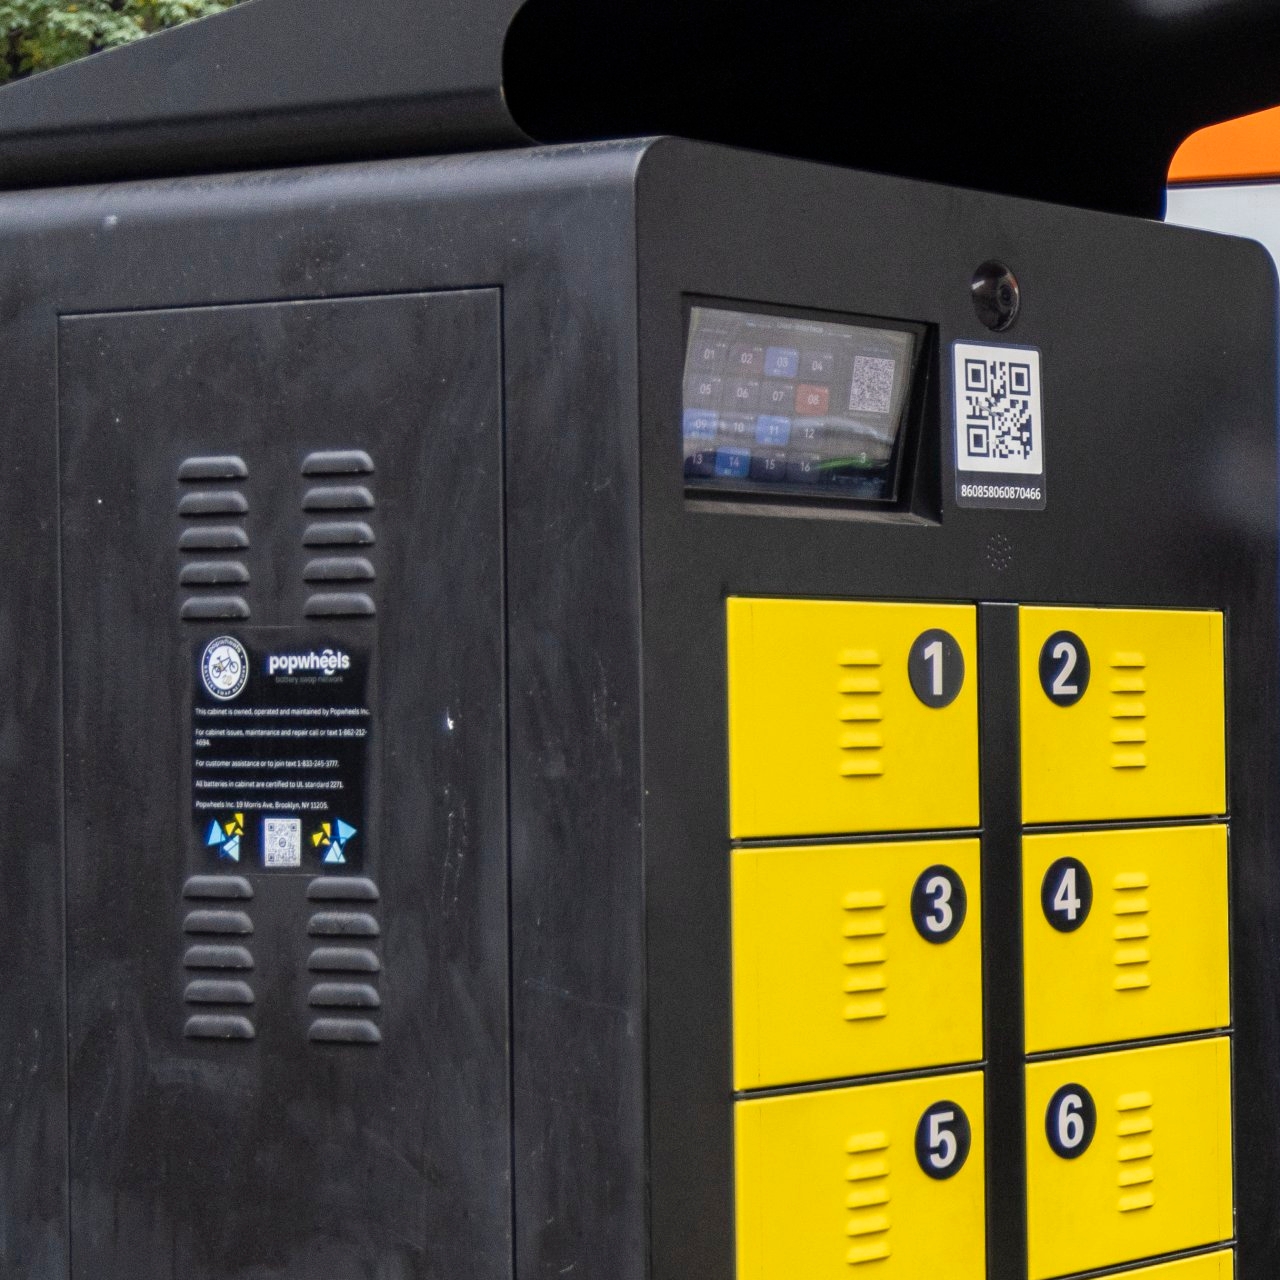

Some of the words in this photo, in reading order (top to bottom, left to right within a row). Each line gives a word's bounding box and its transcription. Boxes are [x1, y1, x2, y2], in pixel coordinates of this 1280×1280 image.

[741, 352, 753, 364] 02
[772, 391, 784, 401] 07
[804, 428, 814, 439] 12
[765, 459, 775, 470] 15
[800, 461, 811, 472] 16
[961, 485, 1041, 499] 860858060870466
[270, 650, 350, 675] popwheels
[924, 641, 943, 696] 1
[1052, 641, 1078, 695] 2
[925, 876, 953, 932] 3
[1053, 868, 1081, 920] 4
[929, 1111, 957, 1168] 5
[1058, 1094, 1084, 1148] 6
